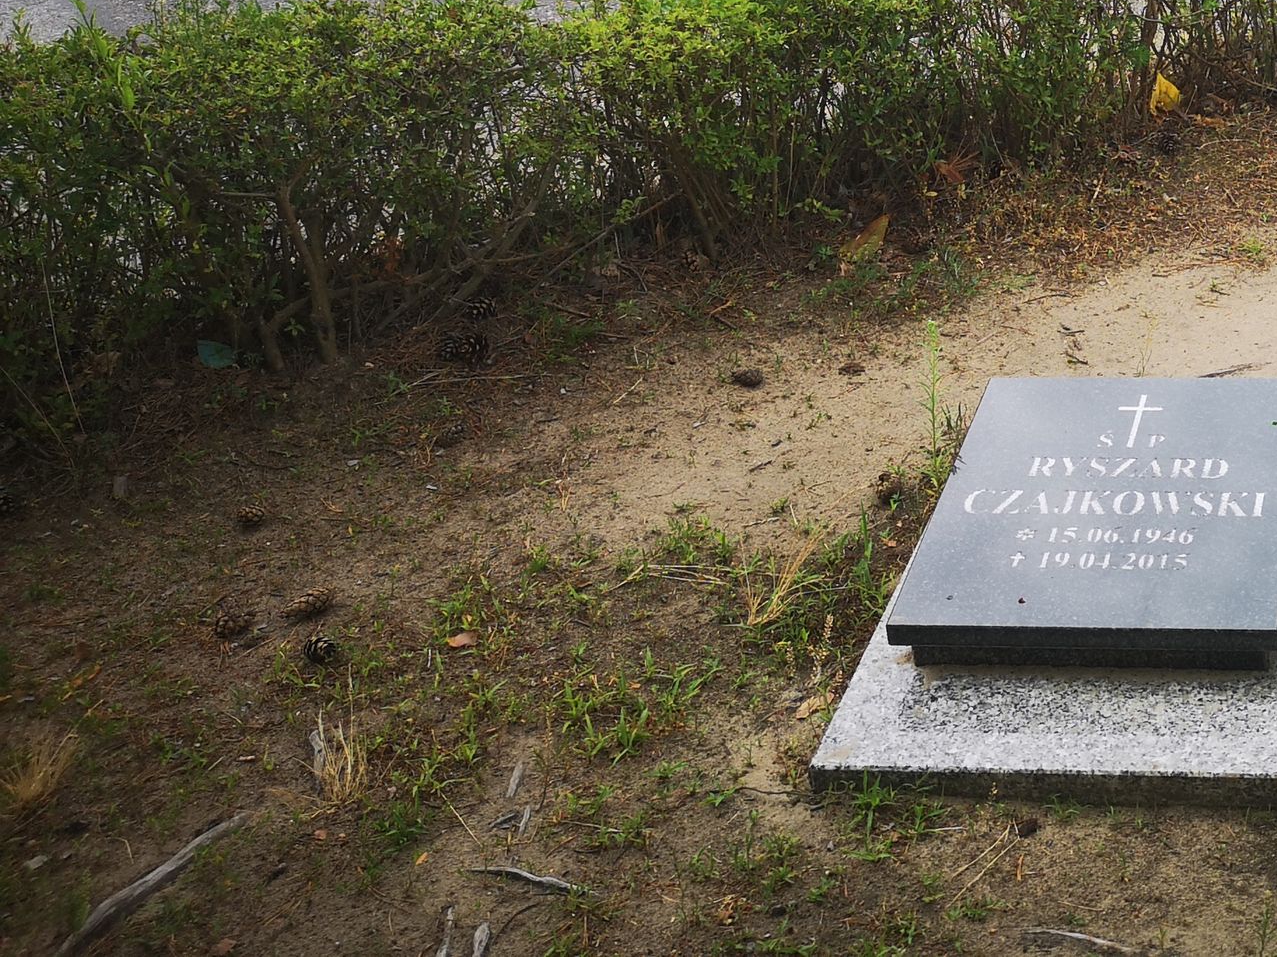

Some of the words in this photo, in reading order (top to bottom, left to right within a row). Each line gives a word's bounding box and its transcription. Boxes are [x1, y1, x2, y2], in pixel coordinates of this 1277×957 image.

[1027, 456, 1231, 480] RYSZARD
[963, 489, 1267, 518] CZAJKOWSKI
[1047, 526, 1200, 546] 15.06.1946
[1038, 551, 1192, 572] 19.04.2015
